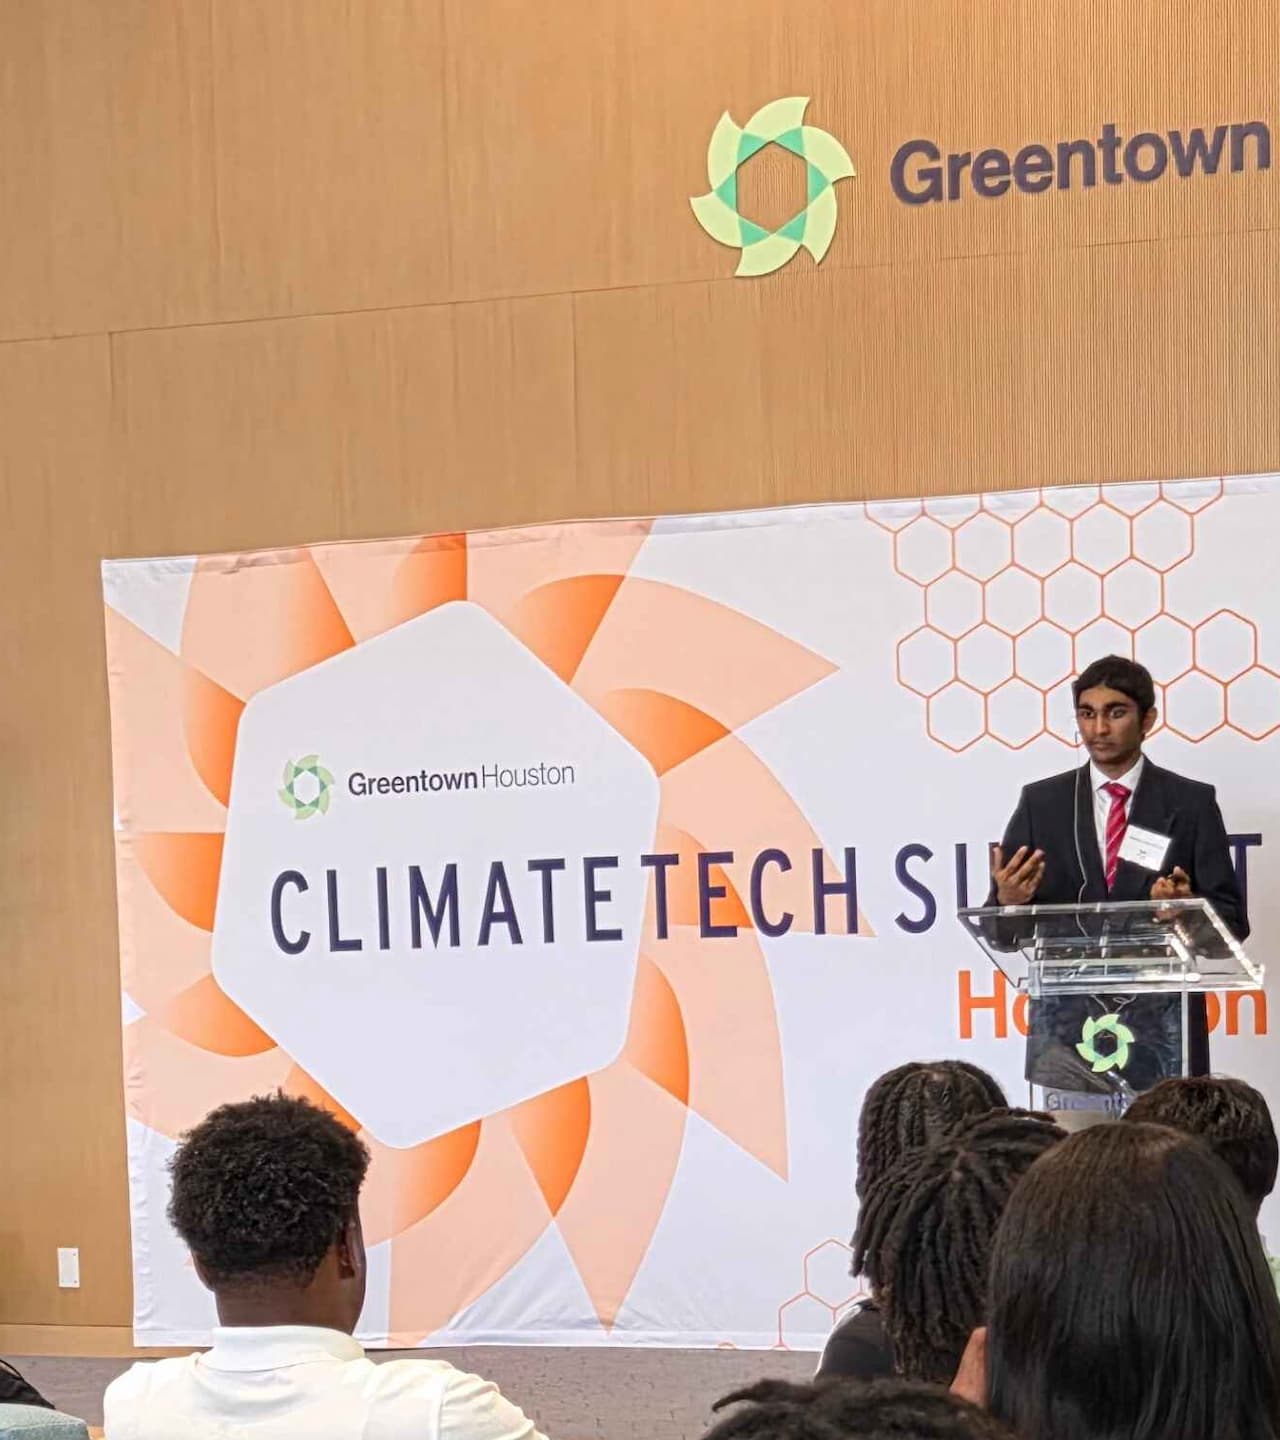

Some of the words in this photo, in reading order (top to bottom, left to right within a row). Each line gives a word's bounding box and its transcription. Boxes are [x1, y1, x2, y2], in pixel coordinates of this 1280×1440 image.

[890, 121, 1271, 206] Greentown
[348, 769, 478, 796] Greentown
[481, 762, 575, 789] Houston
[894, 832, 1263, 934] SUT
